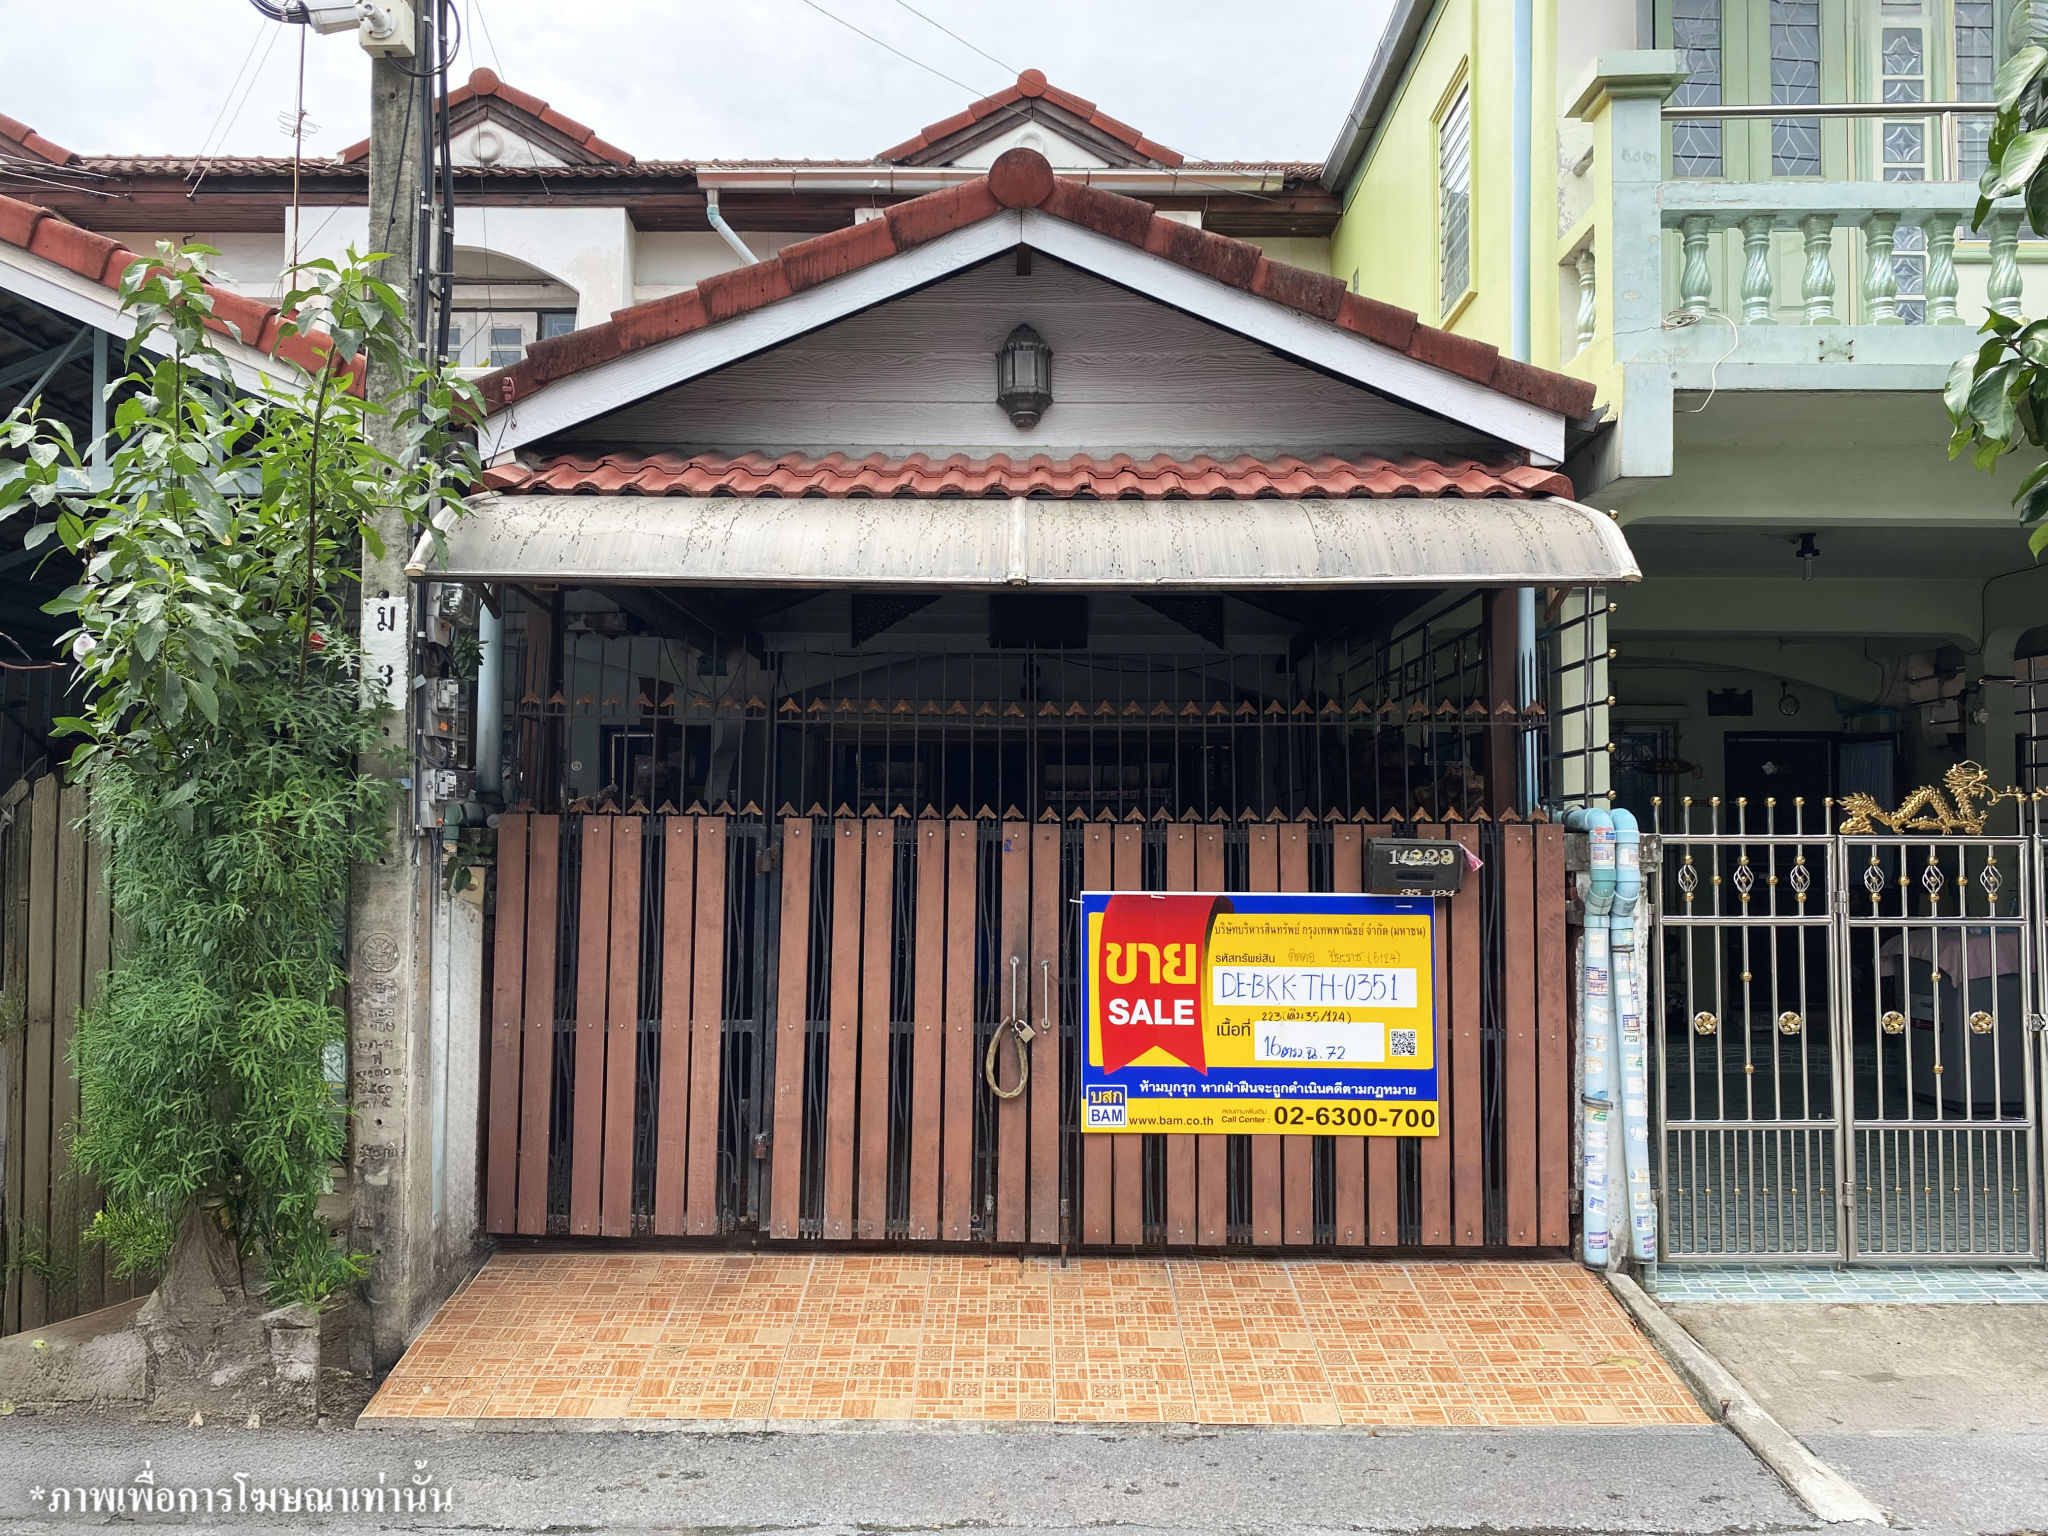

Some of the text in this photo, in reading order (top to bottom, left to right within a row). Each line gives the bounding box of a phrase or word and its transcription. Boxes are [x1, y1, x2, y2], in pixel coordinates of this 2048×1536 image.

[376, 605, 397, 632] ม
[378, 664, 393, 686] 3
[1105, 942, 1197, 985] ขาย
[1215, 952, 1276, 964] รหัสทรัพย์สิน
[1108, 998, 1195, 1025] SALE
[1216, 1018, 1251, 1037] เนื้อที่
[1090, 1089, 1124, 1104] บสก
[1139, 1080, 1196, 1097] ห้ามบุกรุก
[1091, 1109, 1123, 1122] BAM
[1128, 1115, 1214, 1126] www.bam.co.th
[1221, 1115, 1237, 1123] Call
[1238, 1115, 1266, 1123] Center
[1274, 1106, 1436, 1128] 02-6300-700
